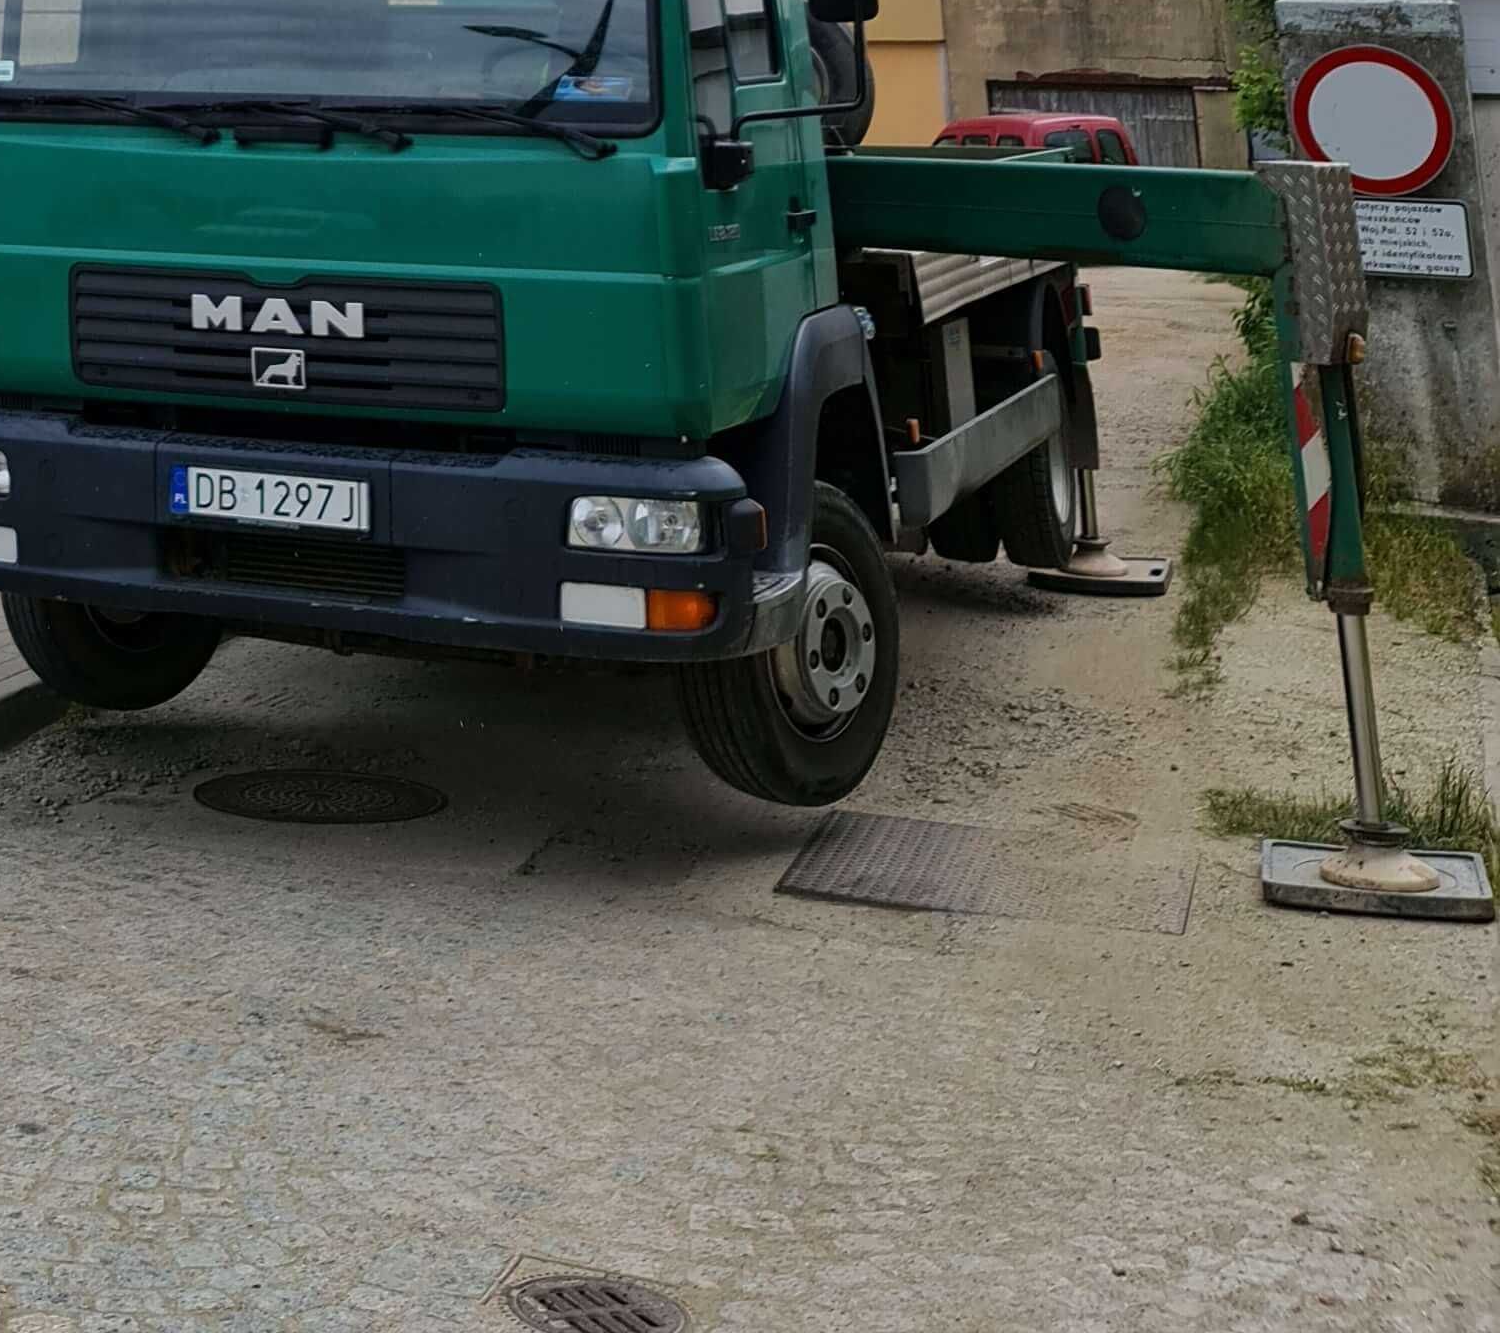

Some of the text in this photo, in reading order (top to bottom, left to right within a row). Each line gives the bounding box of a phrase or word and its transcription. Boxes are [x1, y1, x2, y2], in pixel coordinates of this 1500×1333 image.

[1405, 226, 1417, 236] 52
[1382, 249, 1464, 261] identyfikatorem
[191, 294, 364, 338] MAN
[195, 473, 355, 523] DB 1297J
